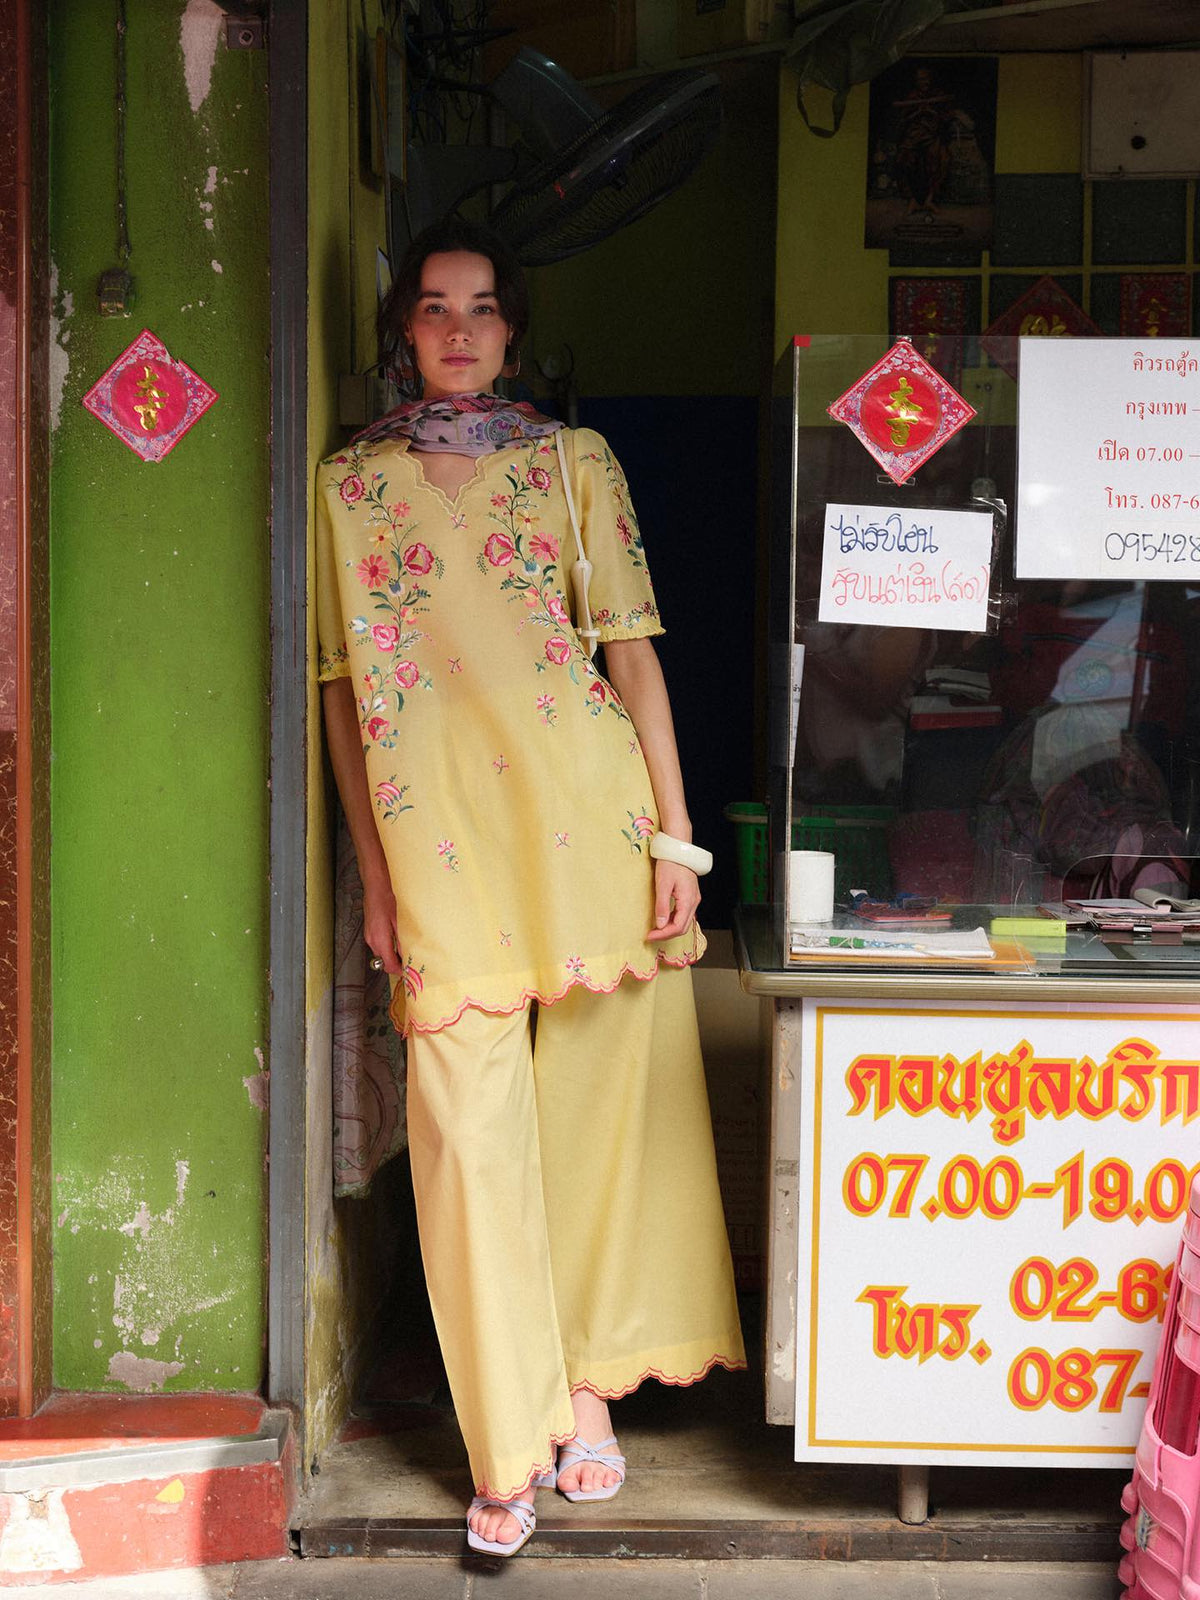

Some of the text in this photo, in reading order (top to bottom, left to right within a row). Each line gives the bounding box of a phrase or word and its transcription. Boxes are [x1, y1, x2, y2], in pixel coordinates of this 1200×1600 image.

[1125, 400, 1187, 421] กรุงเทพ
[1097, 439, 1184, 462] เปิด 07.00
[1104, 486, 1144, 509] โทร.
[841, 1149, 1199, 1231] 07.00-19.0
[1008, 1255, 1175, 1324] 02-6
[855, 1284, 992, 1365] โทร.
